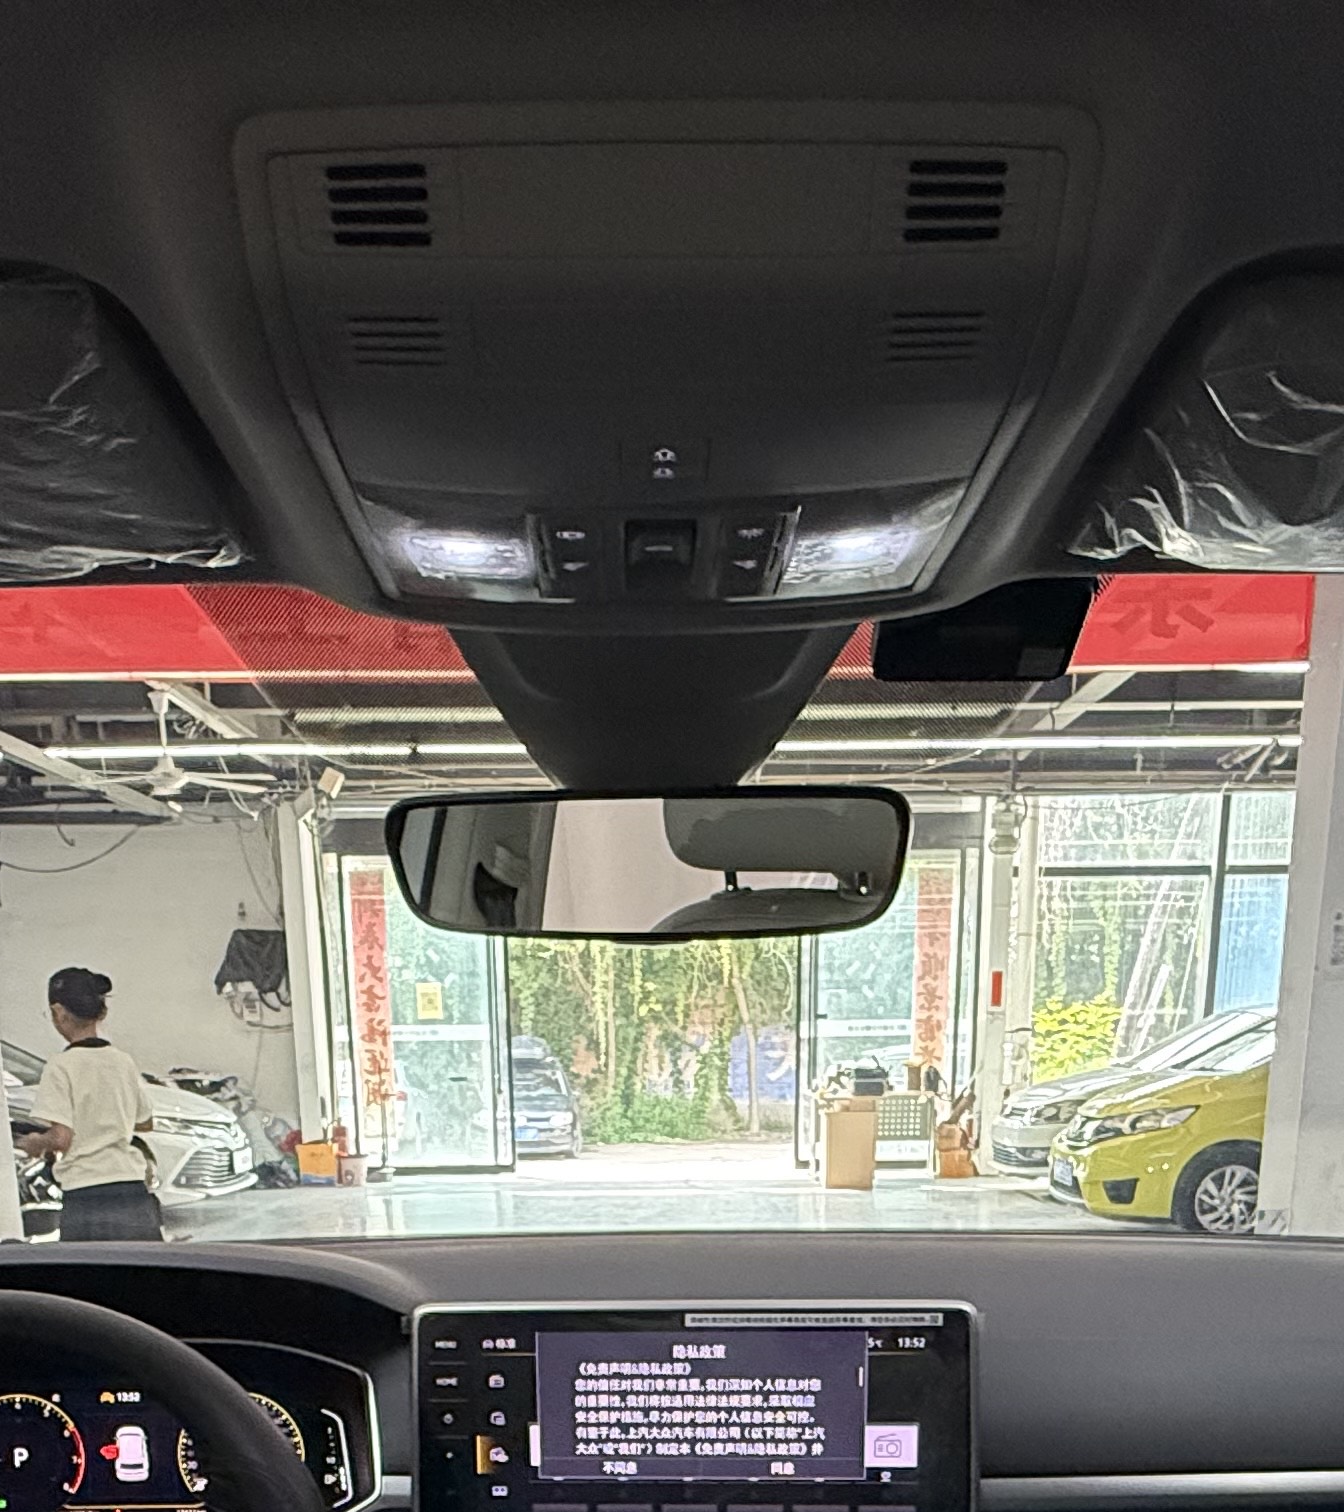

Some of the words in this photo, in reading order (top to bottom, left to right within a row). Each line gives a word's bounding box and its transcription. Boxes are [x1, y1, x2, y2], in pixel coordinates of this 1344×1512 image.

[897, 1337, 926, 1349] 13:52
[672, 1344, 727, 1359] 隐私政策
[13, 1447, 29, 1468] P
